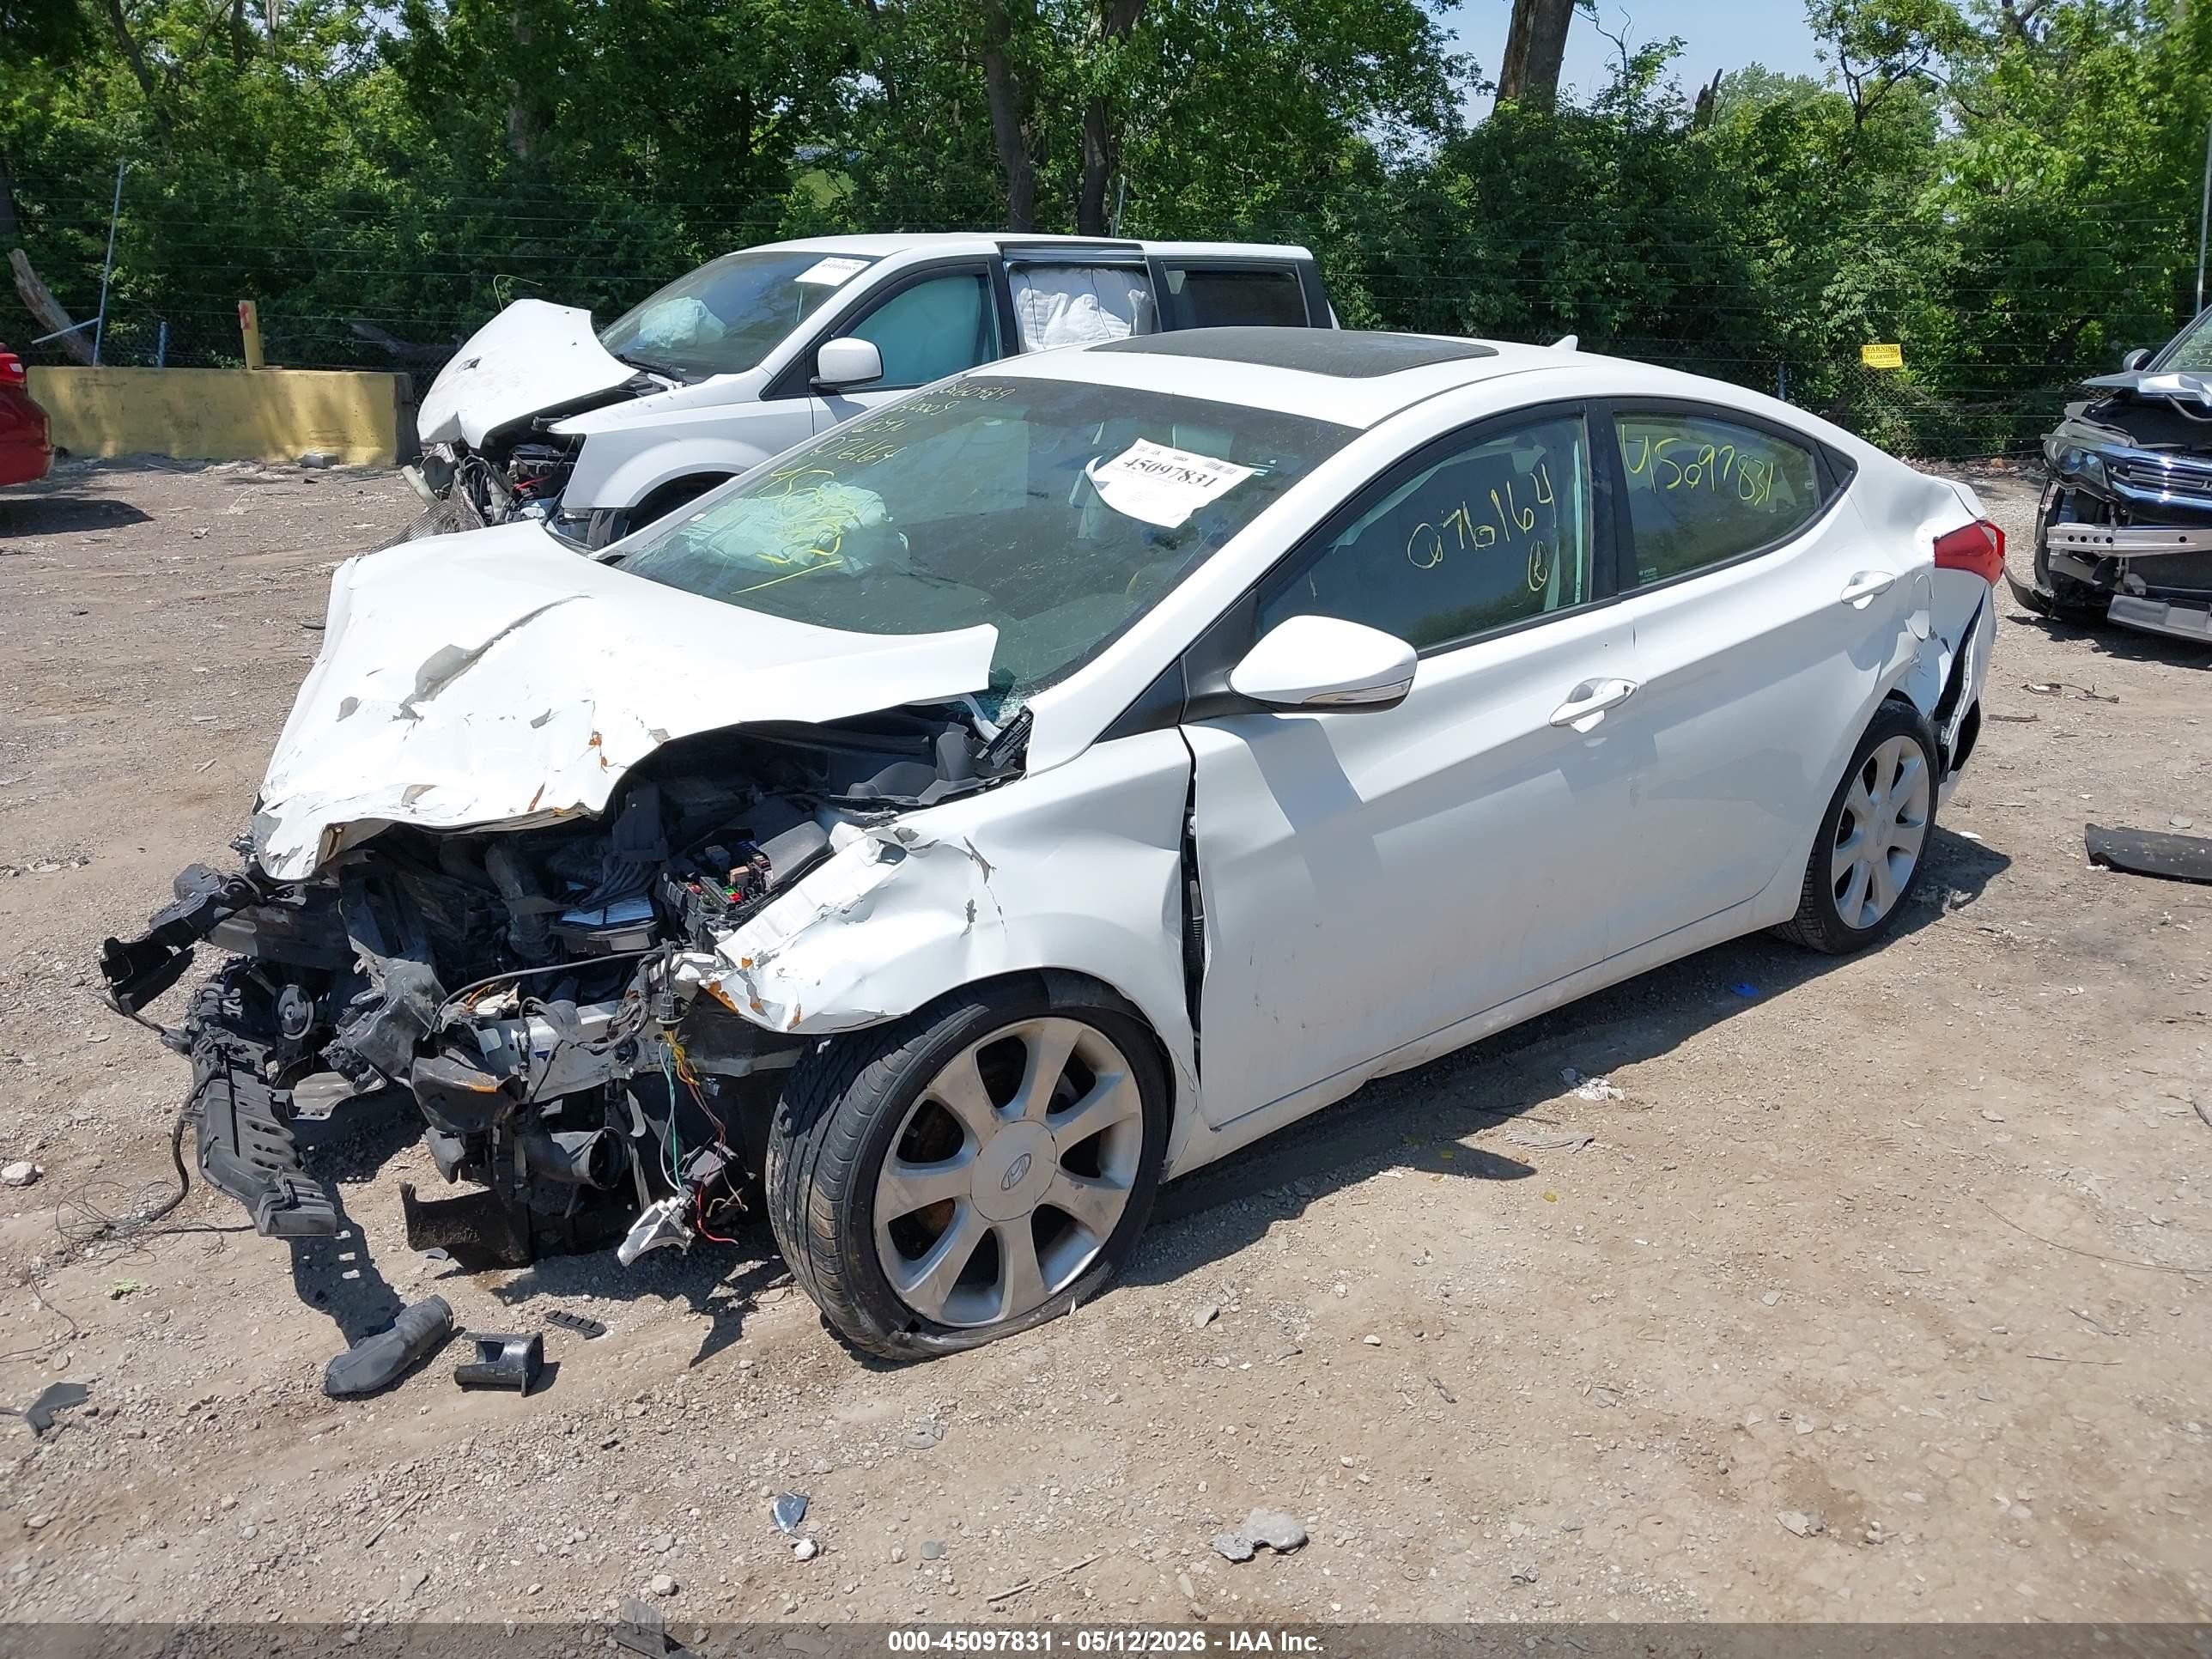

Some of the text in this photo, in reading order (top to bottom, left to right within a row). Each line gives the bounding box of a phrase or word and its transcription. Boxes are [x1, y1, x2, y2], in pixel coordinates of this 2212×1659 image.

[1123, 458, 1218, 488] 45097831
[1621, 423, 1775, 507] 45097831
[1407, 463, 1557, 568] 076164
